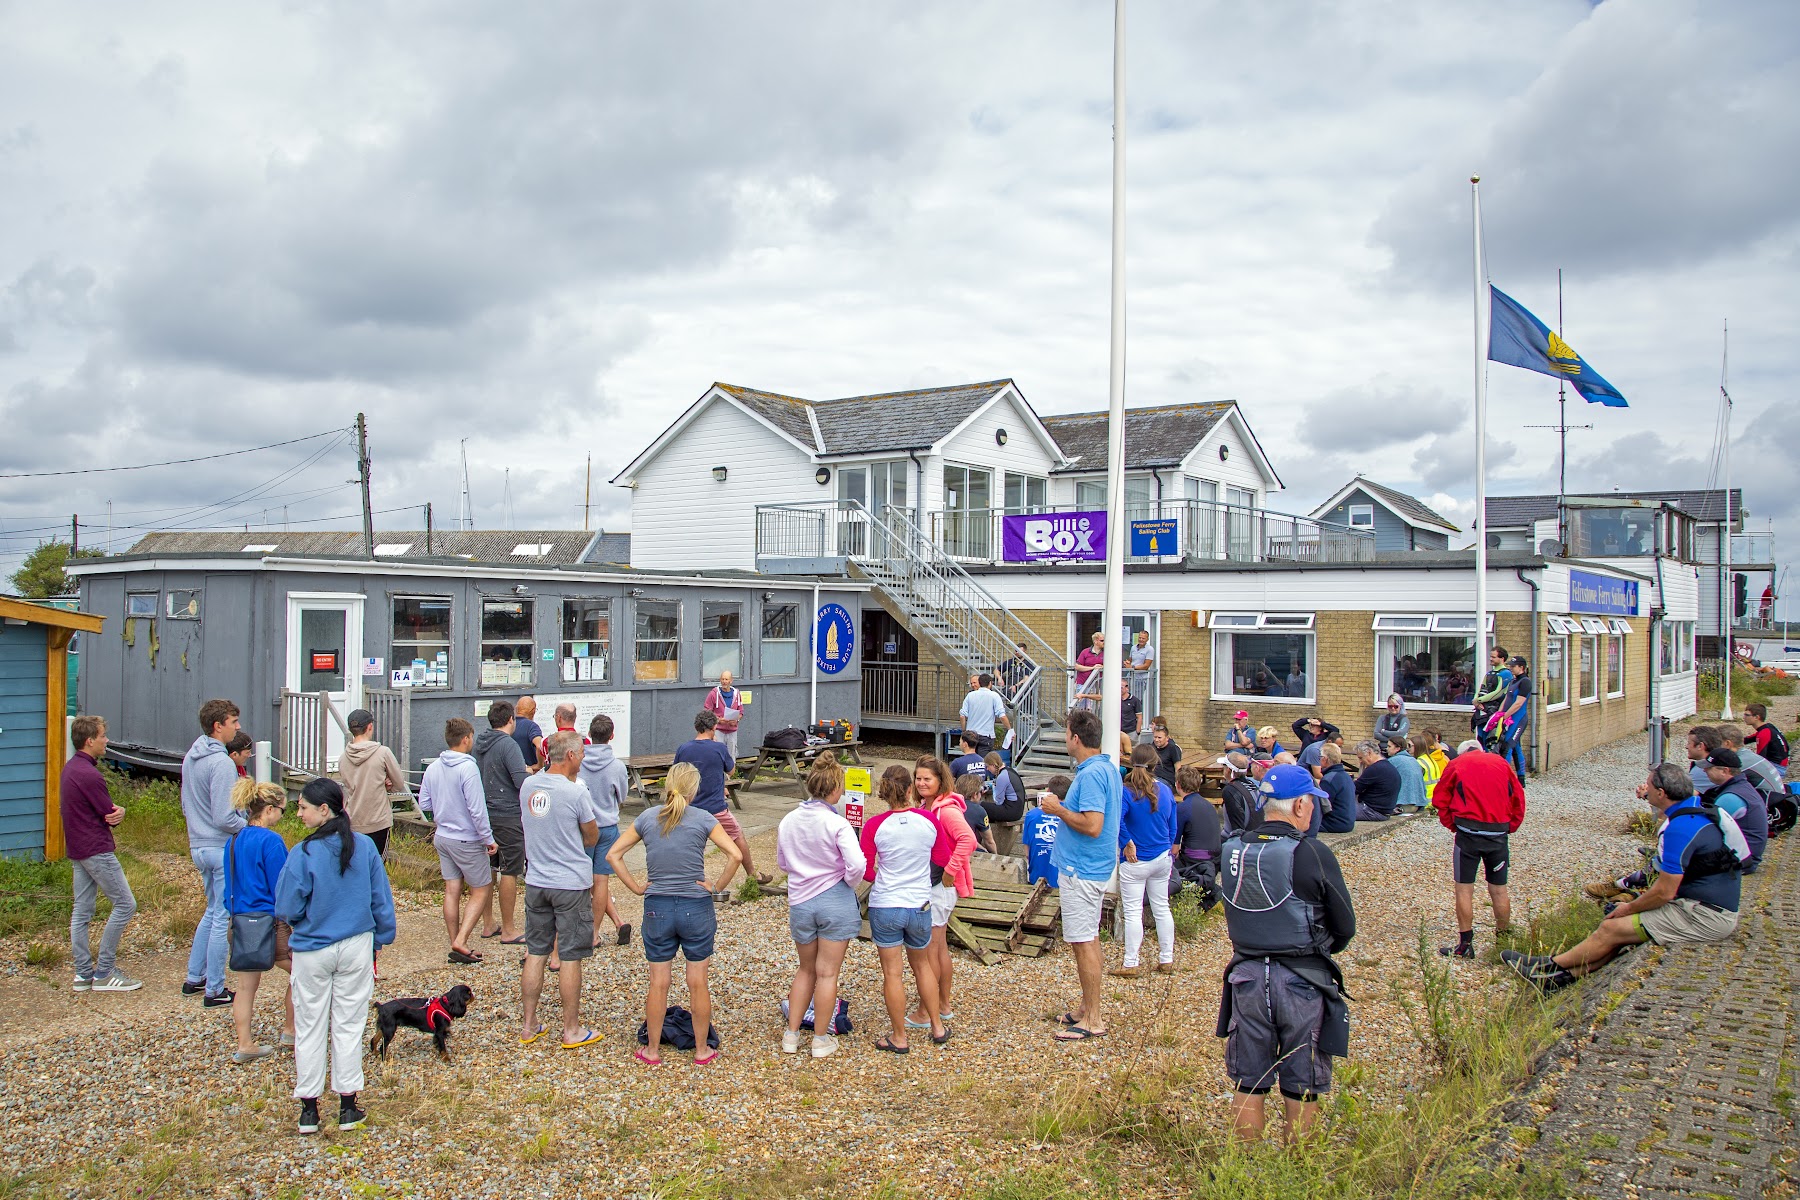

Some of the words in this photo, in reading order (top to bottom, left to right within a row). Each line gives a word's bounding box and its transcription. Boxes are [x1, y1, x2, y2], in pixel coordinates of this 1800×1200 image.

[1572, 581, 1597, 603] Felixstowe
[1598, 585, 1611, 610] Ferry
[1611, 586, 1626, 611] Sailing
[1627, 589, 1636, 607] Club
[817, 607, 830, 621] ERRY
[835, 608, 852, 634] SAILING
[842, 643, 852, 663] CLUB
[967, 762, 985, 771] BLAZE
[1230, 849, 1240, 876] Gill
